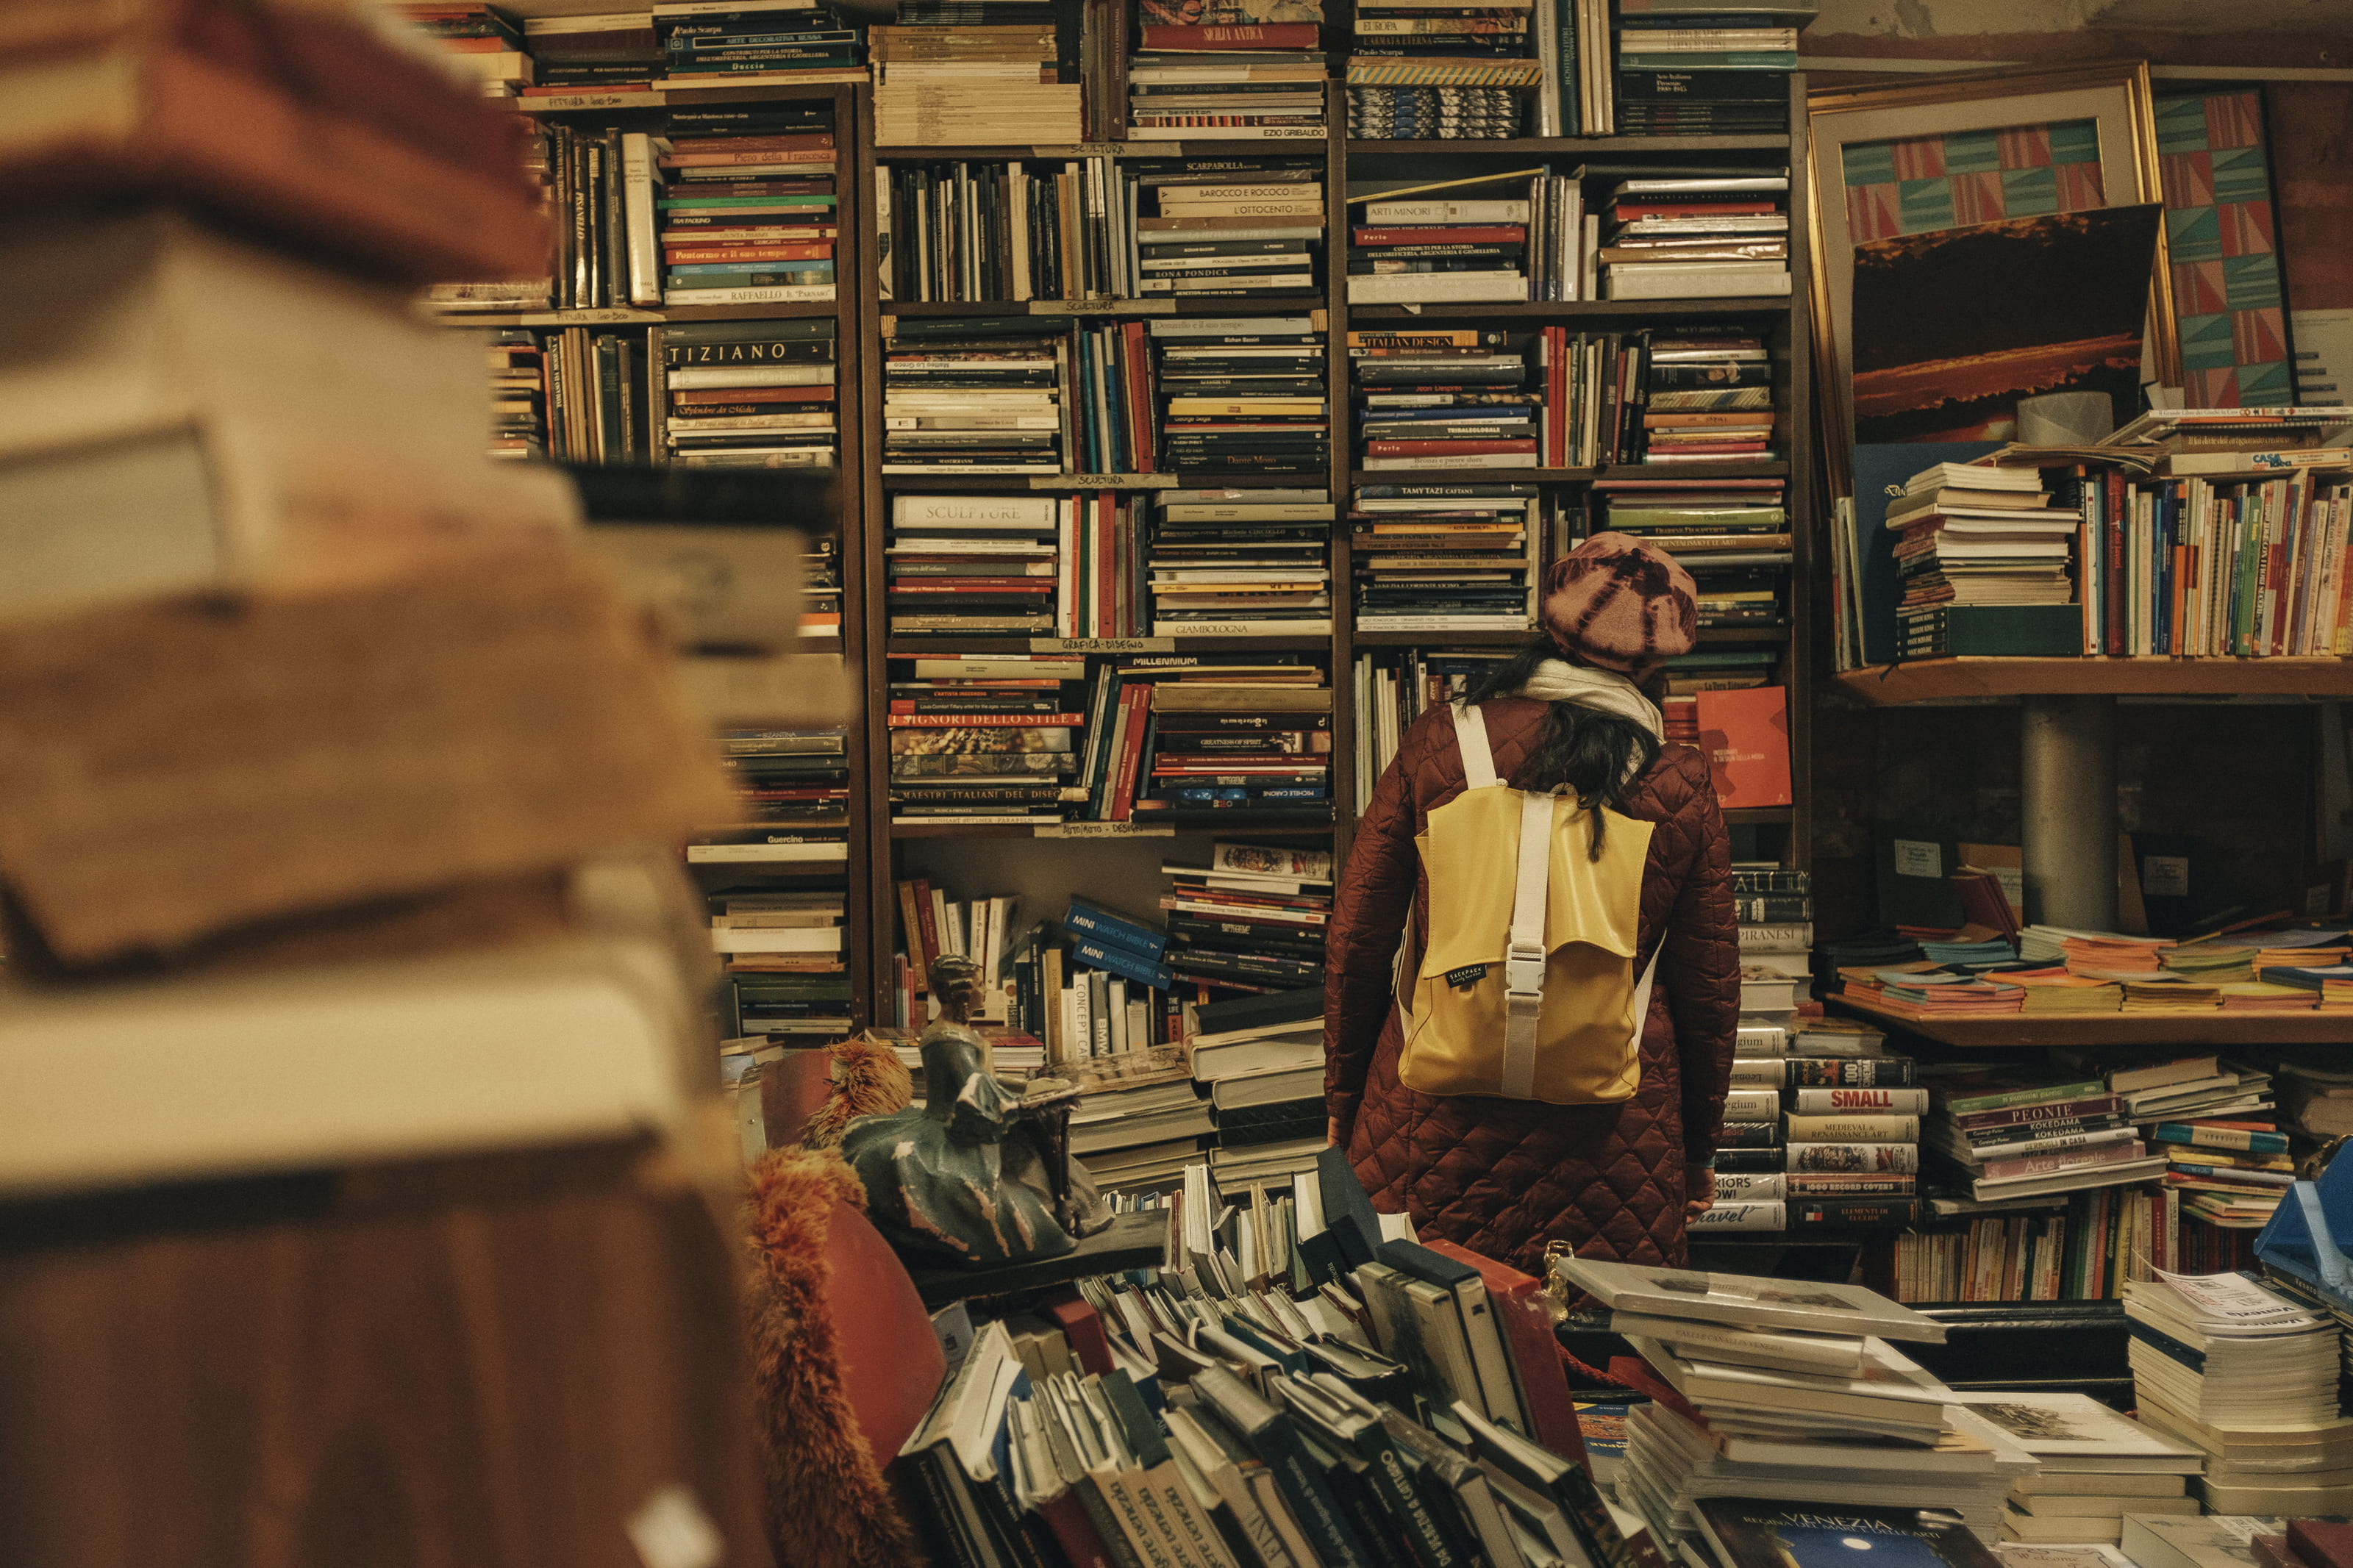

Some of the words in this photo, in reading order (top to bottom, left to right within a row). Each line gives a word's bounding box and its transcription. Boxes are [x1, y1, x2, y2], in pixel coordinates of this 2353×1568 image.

[1363, 21, 1398, 32] EUROPA
[1204, 27, 1232, 41] SICILIA
[1235, 27, 1265, 40] ANTICA
[1379, 49, 1404, 57] Scarpa
[1284, 129, 1325, 137] GRIBAUDO
[1071, 143, 1126, 155] SCULTURA
[735, 152, 757, 162] Piero
[761, 151, 783, 161] della
[788, 150, 831, 160] Francesca
[1199, 189, 1242, 198] BAROCCO
[1244, 189, 1249, 197] E
[1251, 187, 1290, 196] ROCOCO
[1234, 204, 1293, 214] L'OTTOCENTO
[1370, 207, 1392, 216] ARTI
[1393, 207, 1431, 216] MINORI
[576, 191, 586, 240] PISANELLO
[676, 251, 720, 259] Pontormo
[730, 250, 737, 258] il
[759, 250, 788, 258] tempo
[1185, 269, 1229, 277] PONDICK
[731, 291, 782, 301] RAFFAELLO
[1066, 301, 1115, 312] SCULTURA
[1220, 321, 1244, 331] tempo
[1367, 337, 1410, 347] ITALIAN
[1411, 337, 1452, 347] DESIGN
[669, 343, 785, 362] TIZIANO
[2252, 454, 2282, 463] CASA
[1078, 474, 1125, 485] SCULTURA
[1426, 487, 1443, 495] TAZI
[926, 506, 1021, 519] SCULPTURE
[1175, 625, 1249, 634] GIAMBOLOGNA
[1133, 657, 1198, 666] MILLENNIUM
[891, 715, 897, 725] I
[904, 715, 967, 725] SIGNORI
[973, 714, 1021, 725] DELLO
[1026, 714, 1069, 724] STILE
[903, 791, 946, 800] MAESTRI
[952, 790, 999, 799] ITALIANI
[1004, 790, 1024, 799] DEL
[767, 834, 804, 844] Guercino
[1072, 914, 1096, 930] MINI
[1096, 923, 1126, 940] WATCH
[1126, 933, 1149, 948] BIBLE
[1081, 945, 1104, 960] MINI
[1104, 952, 1134, 970] WATCH
[1133, 962, 1157, 978] BIBLE
[1076, 983, 1088, 1034] CONCEPT
[1168, 1004, 1179, 1014] LIFE
[1097, 1018, 1109, 1056] BMW
[1844, 1063, 1858, 1084] 100
[1831, 1089, 1893, 1108] SMALL
[2012, 1103, 2074, 1123] PEONIE
[1824, 1123, 1868, 1131] MEDIEVAL
[2029, 1117, 2081, 1131] KOKEDAMA
[1811, 1131, 1870, 1139] RENAISSANCE
[2035, 1126, 2085, 1139] KOKEDAMA
[2069, 1136, 2088, 1145] CASA
[2024, 1159, 2055, 1174] Arte
[2058, 1153, 2107, 1167] floreale
[1715, 1177, 1751, 1189] RIORS
[1829, 1183, 1862, 1191] RECORD
[1714, 1189, 1737, 1200] OW!
[1699, 1205, 1751, 1223] ravel
[2226, 1306, 2295, 1317] Venezia
[1110, 1481, 1147, 1538] venezia
[1139, 1486, 1176, 1543] venezia
[1164, 1486, 1204, 1542] venezia
[1779, 1511, 1893, 1531] VENEZIA
[1913, 1531, 1941, 1539] ARTI
[2012, 1551, 2079, 1562] Welcome
